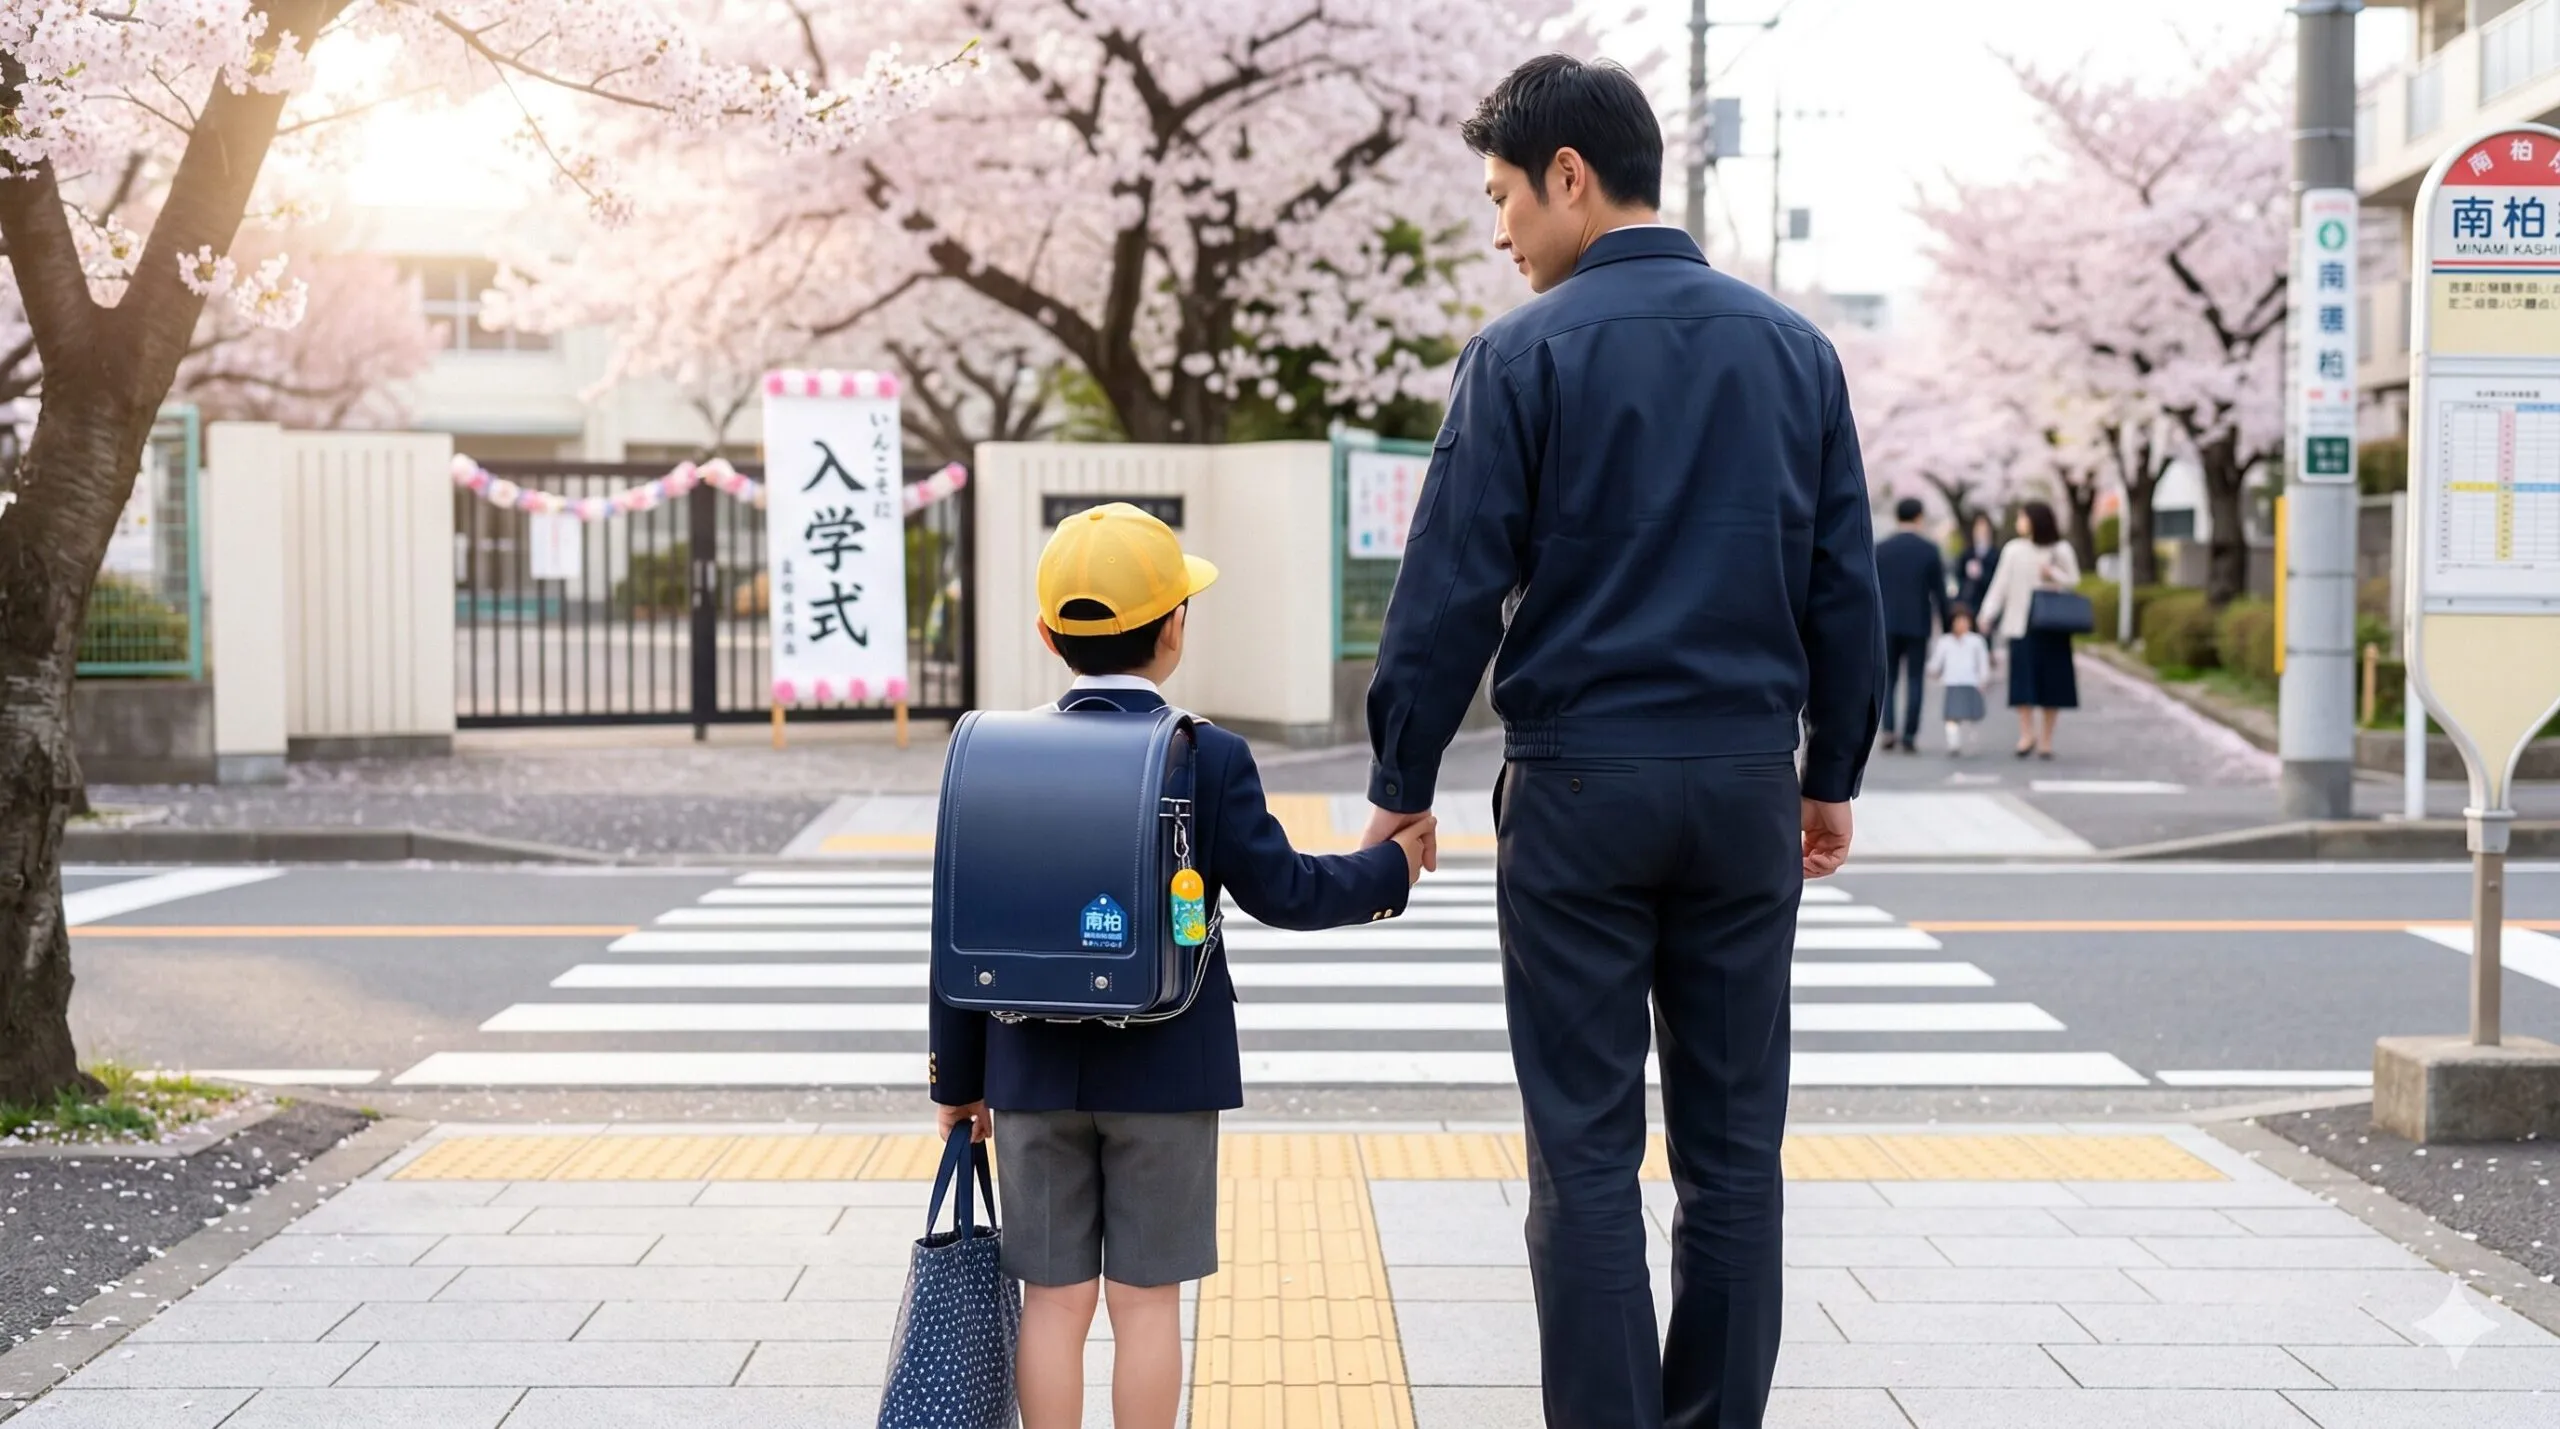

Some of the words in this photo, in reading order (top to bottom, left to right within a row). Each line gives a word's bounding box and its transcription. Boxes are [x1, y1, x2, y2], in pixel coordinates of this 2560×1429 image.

[2452, 195, 2560, 239] 南柏
[2456, 243, 2509, 255] MINAMI
[2514, 243, 2560, 256] KASHI
[801, 440, 868, 648] 入学式
[1085, 910, 1122, 931] 南柏
